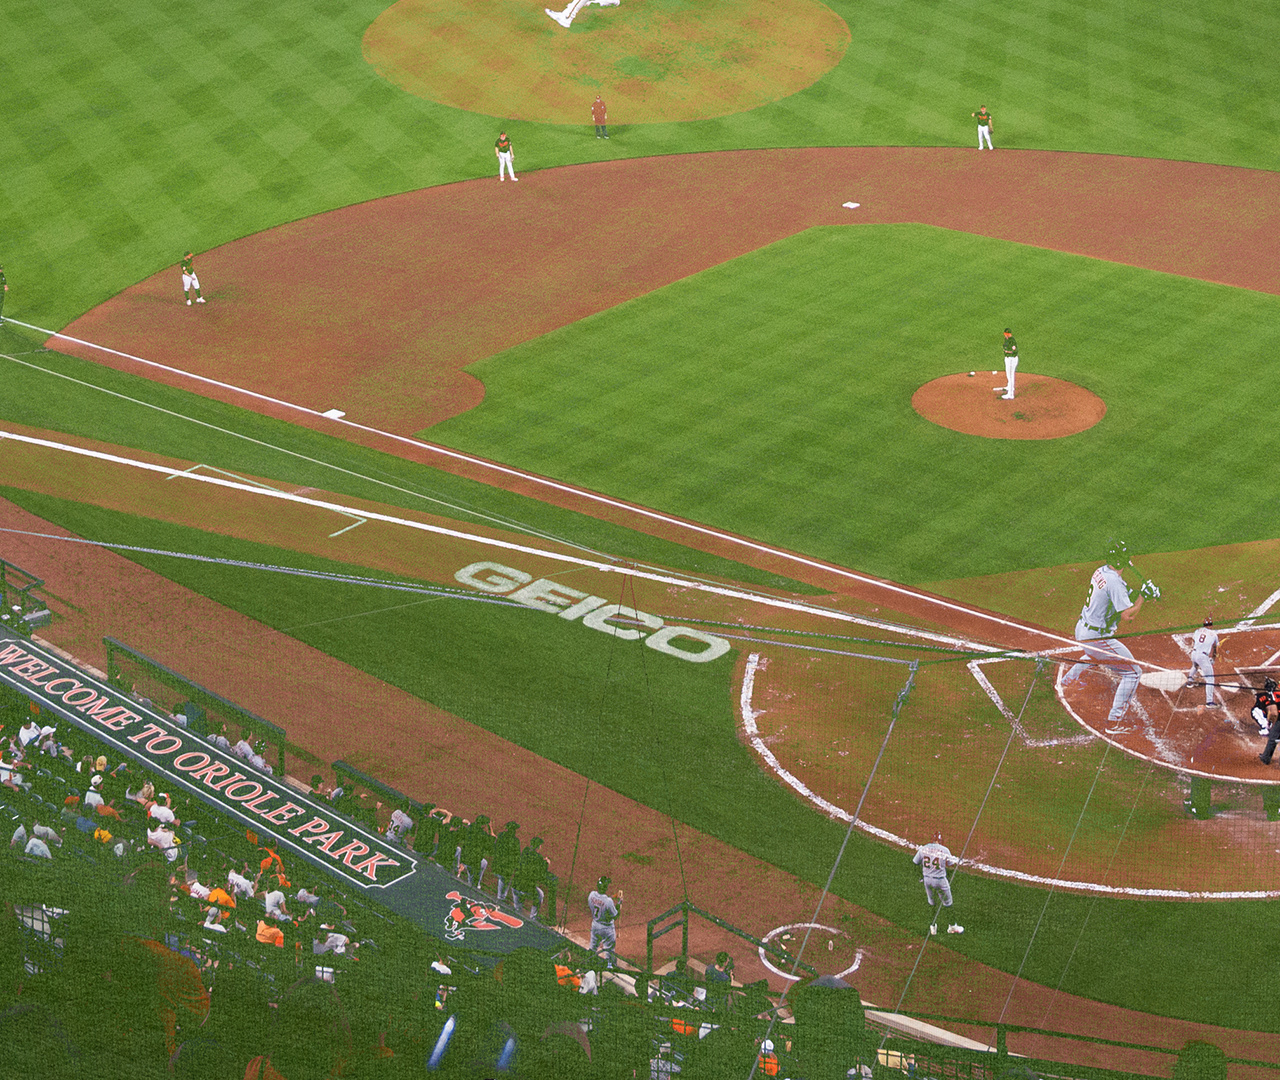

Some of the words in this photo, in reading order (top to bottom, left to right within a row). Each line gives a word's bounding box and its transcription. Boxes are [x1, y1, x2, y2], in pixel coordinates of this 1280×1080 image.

[453, 561, 731, 663] GEICO
[1199, 634, 1206, 643] 8
[128, 722, 182, 755] TO
[173, 751, 306, 826] ORIOLE
[288, 816, 400, 881] PARK
